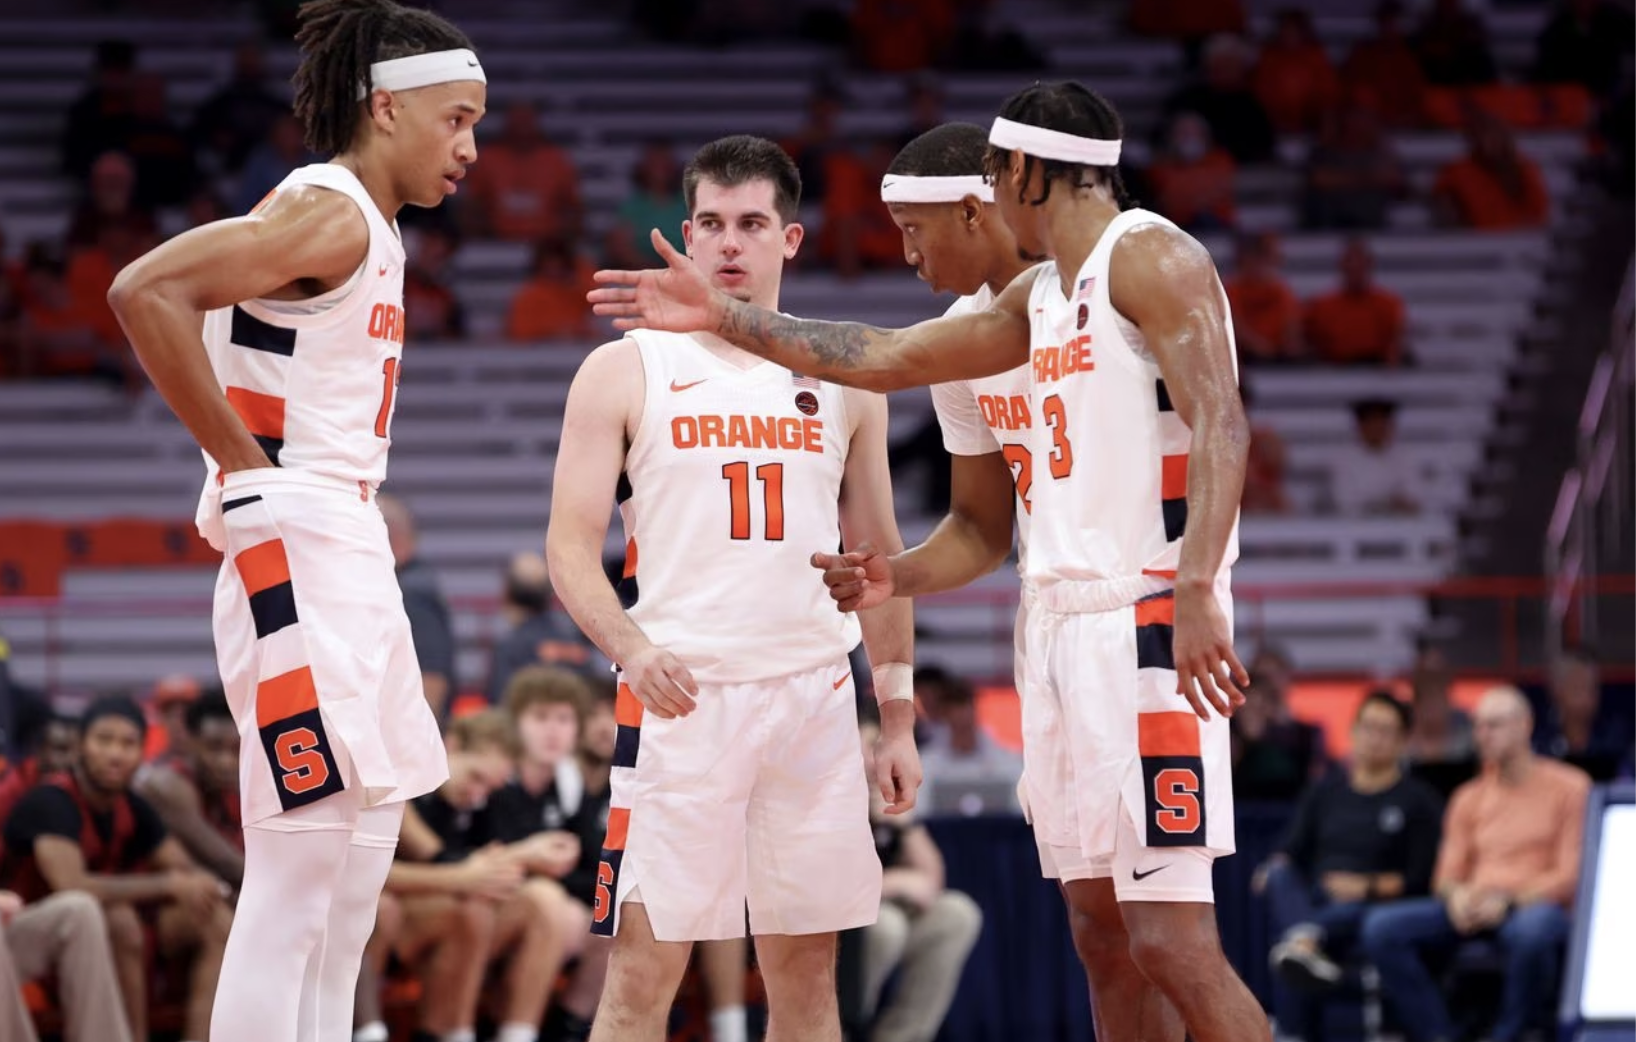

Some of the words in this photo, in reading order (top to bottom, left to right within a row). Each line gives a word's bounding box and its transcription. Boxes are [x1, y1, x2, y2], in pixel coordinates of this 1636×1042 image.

[375, 357, 401, 438] 1
[978, 395, 1031, 430] ORA
[671, 415, 823, 453] ORANGE
[1043, 394, 1073, 479] 3
[722, 461, 784, 541] 11
[1002, 444, 1032, 516] 2
[274, 727, 329, 794] S
[1154, 768, 1201, 833] S
[594, 860, 614, 923] S
